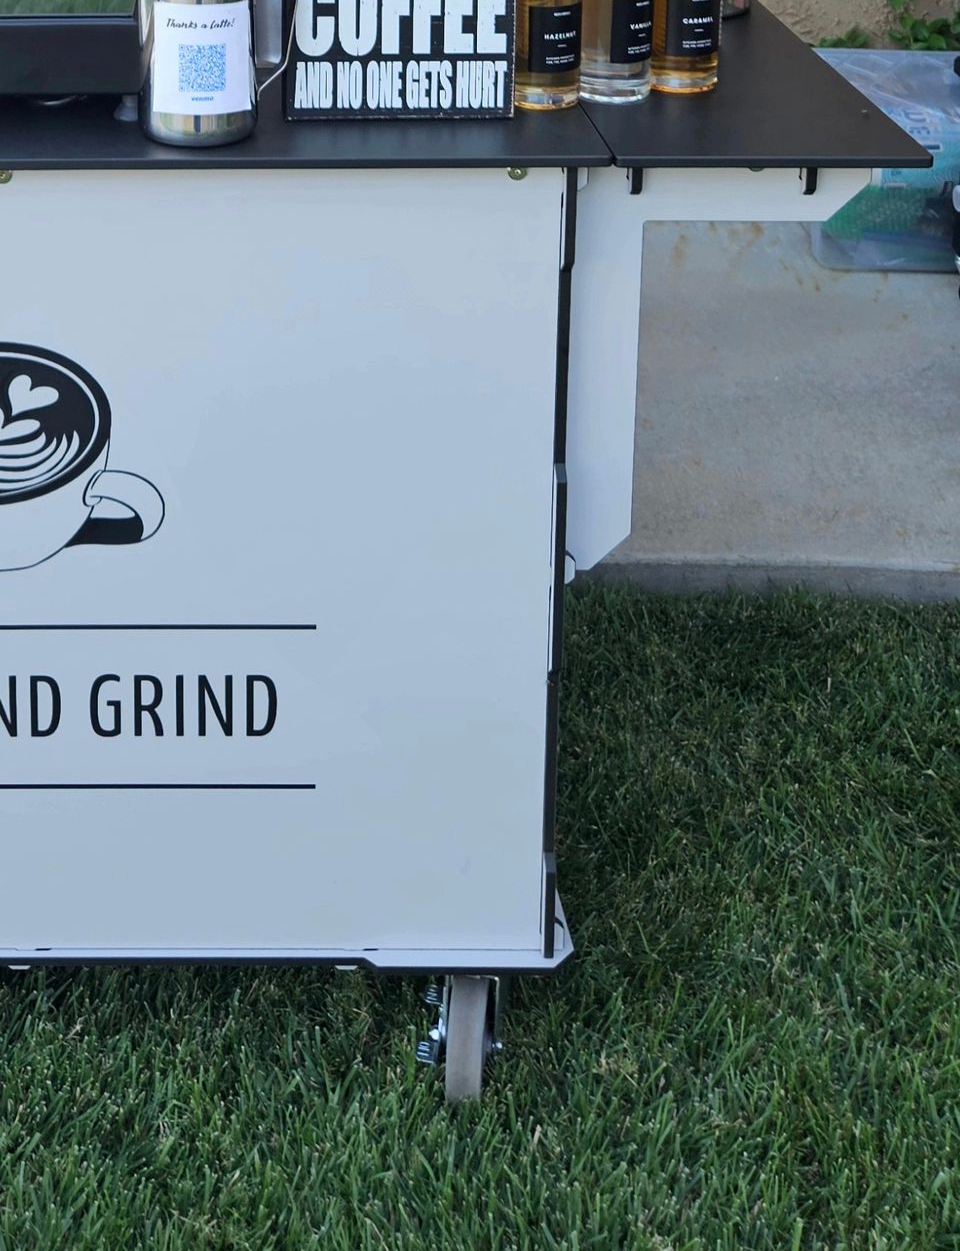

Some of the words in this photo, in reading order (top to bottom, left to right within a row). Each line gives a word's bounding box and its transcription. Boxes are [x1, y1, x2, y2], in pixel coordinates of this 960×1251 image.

[167, 18, 198, 29] Thanks
[682, 16, 714, 25] CARAMEL
[544, 30, 577, 40] HAZELNUT
[294, 60, 334, 109] AND
[337, 60, 363, 109] NO
[366, 60, 403, 109] ONE
[406, 60, 453, 109] GETS
[456, 60, 508, 109] HURT
[89, 673, 278, 738] GRIND
